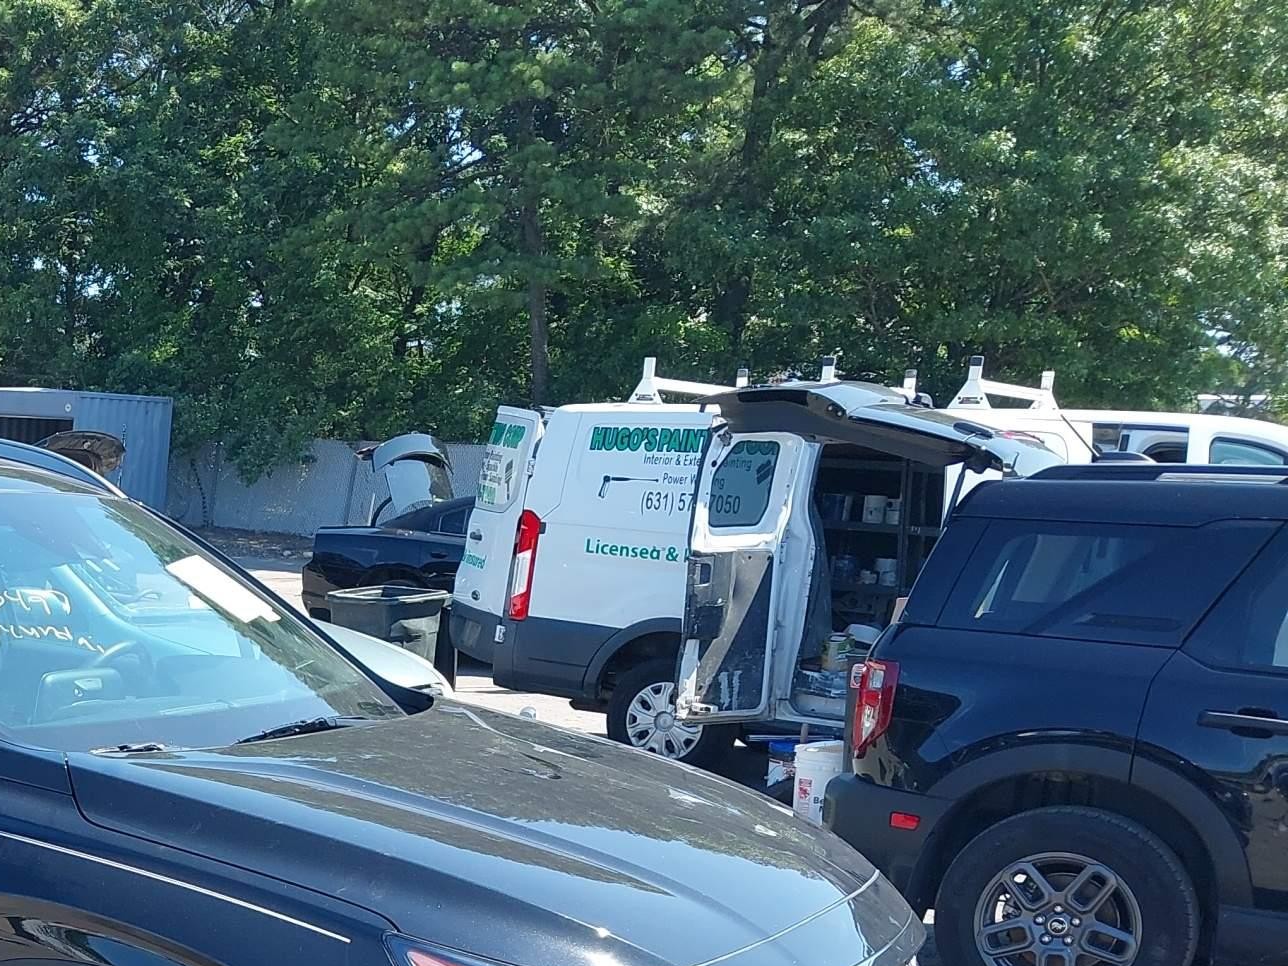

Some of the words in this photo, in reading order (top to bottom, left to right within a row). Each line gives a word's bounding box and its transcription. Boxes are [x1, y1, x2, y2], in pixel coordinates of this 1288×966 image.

[589, 426, 658, 452] HUGO'S
[656, 427, 710, 453] PAINT
[643, 453, 674, 466] Interior
[675, 454, 682, 466] &
[683, 454, 701, 467] Exte
[662, 472, 690, 486] Power
[640, 490, 674, 516] (631)
[665, 546, 679, 563] &
